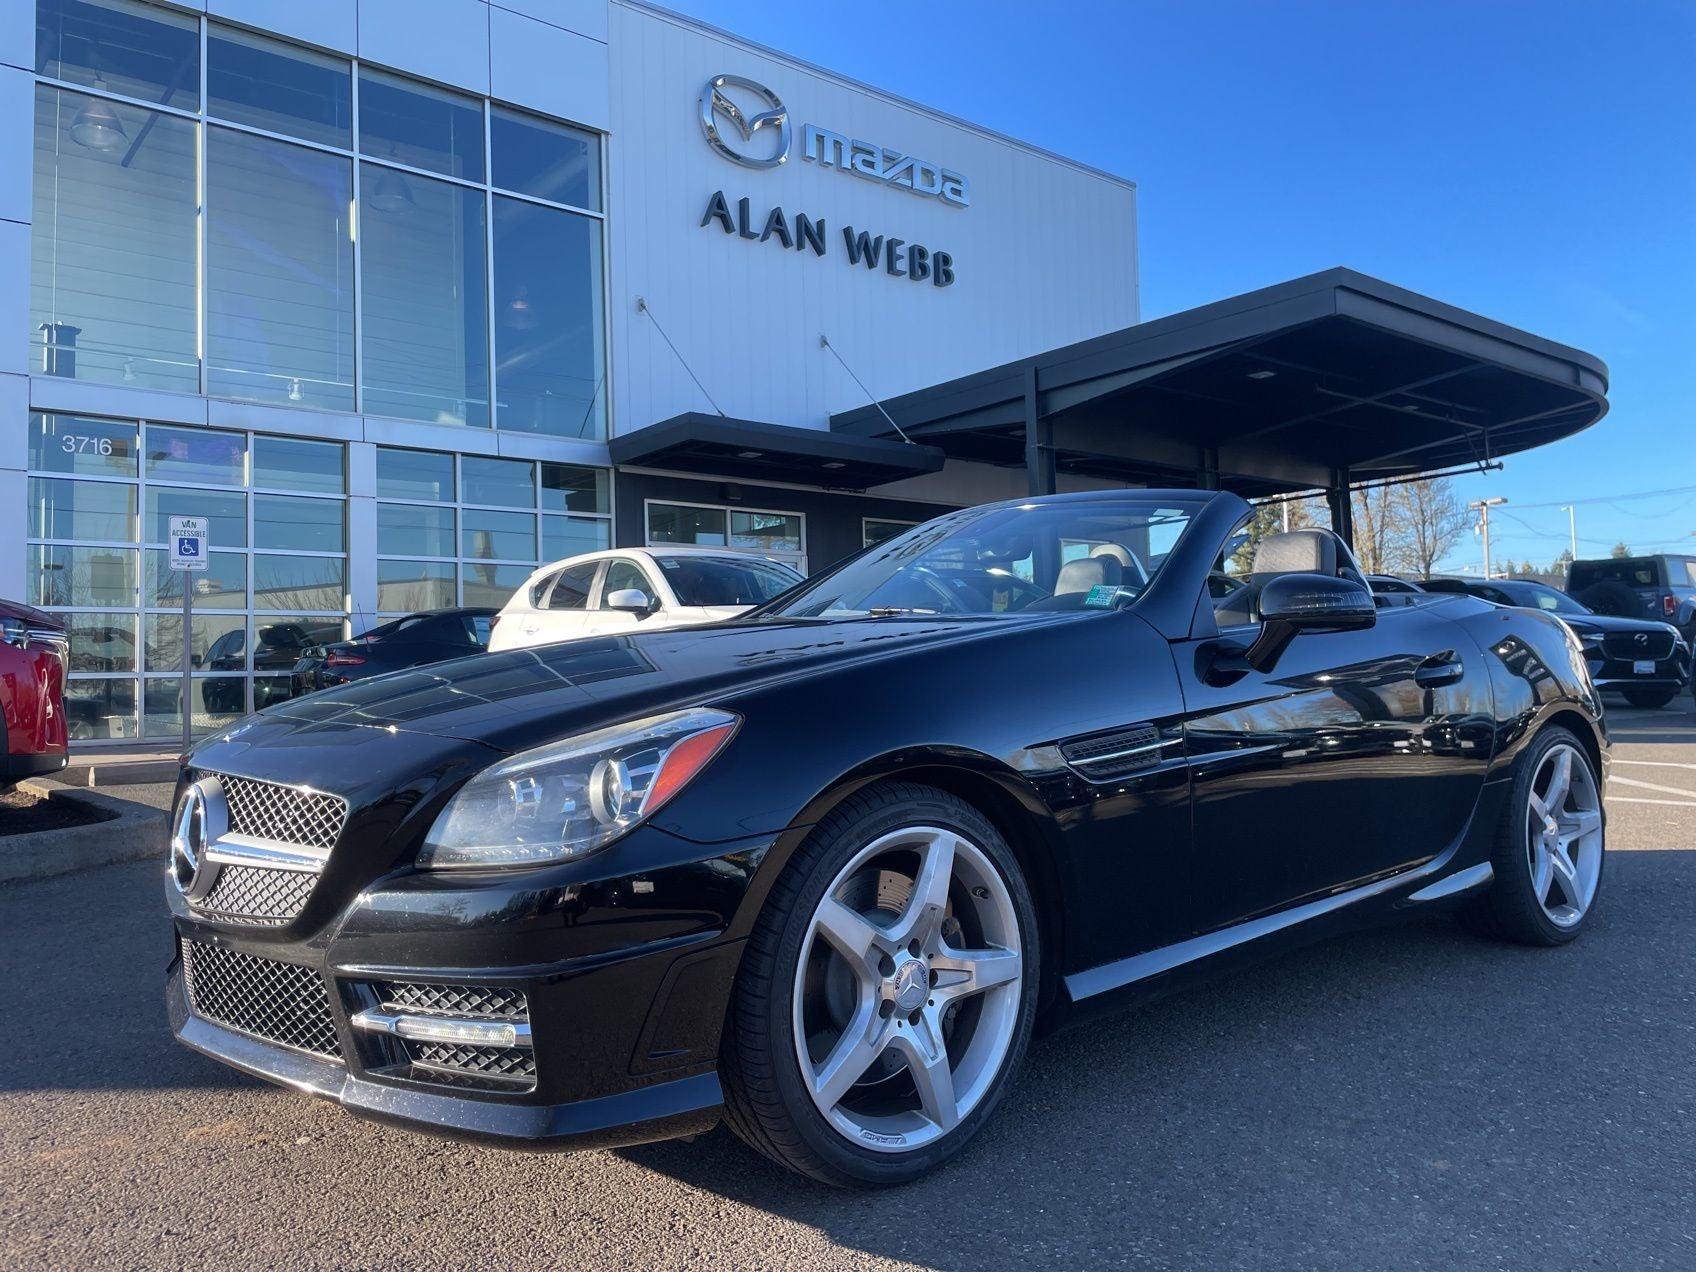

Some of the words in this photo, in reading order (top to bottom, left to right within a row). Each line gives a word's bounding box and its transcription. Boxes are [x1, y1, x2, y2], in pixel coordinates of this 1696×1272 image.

[700, 190, 827, 257] ALAN
[842, 225, 955, 287] WEBB
[61, 435, 113, 456] 3716
[181, 520, 198, 529] VAN
[171, 529, 206, 538] ACCESSIBLE
